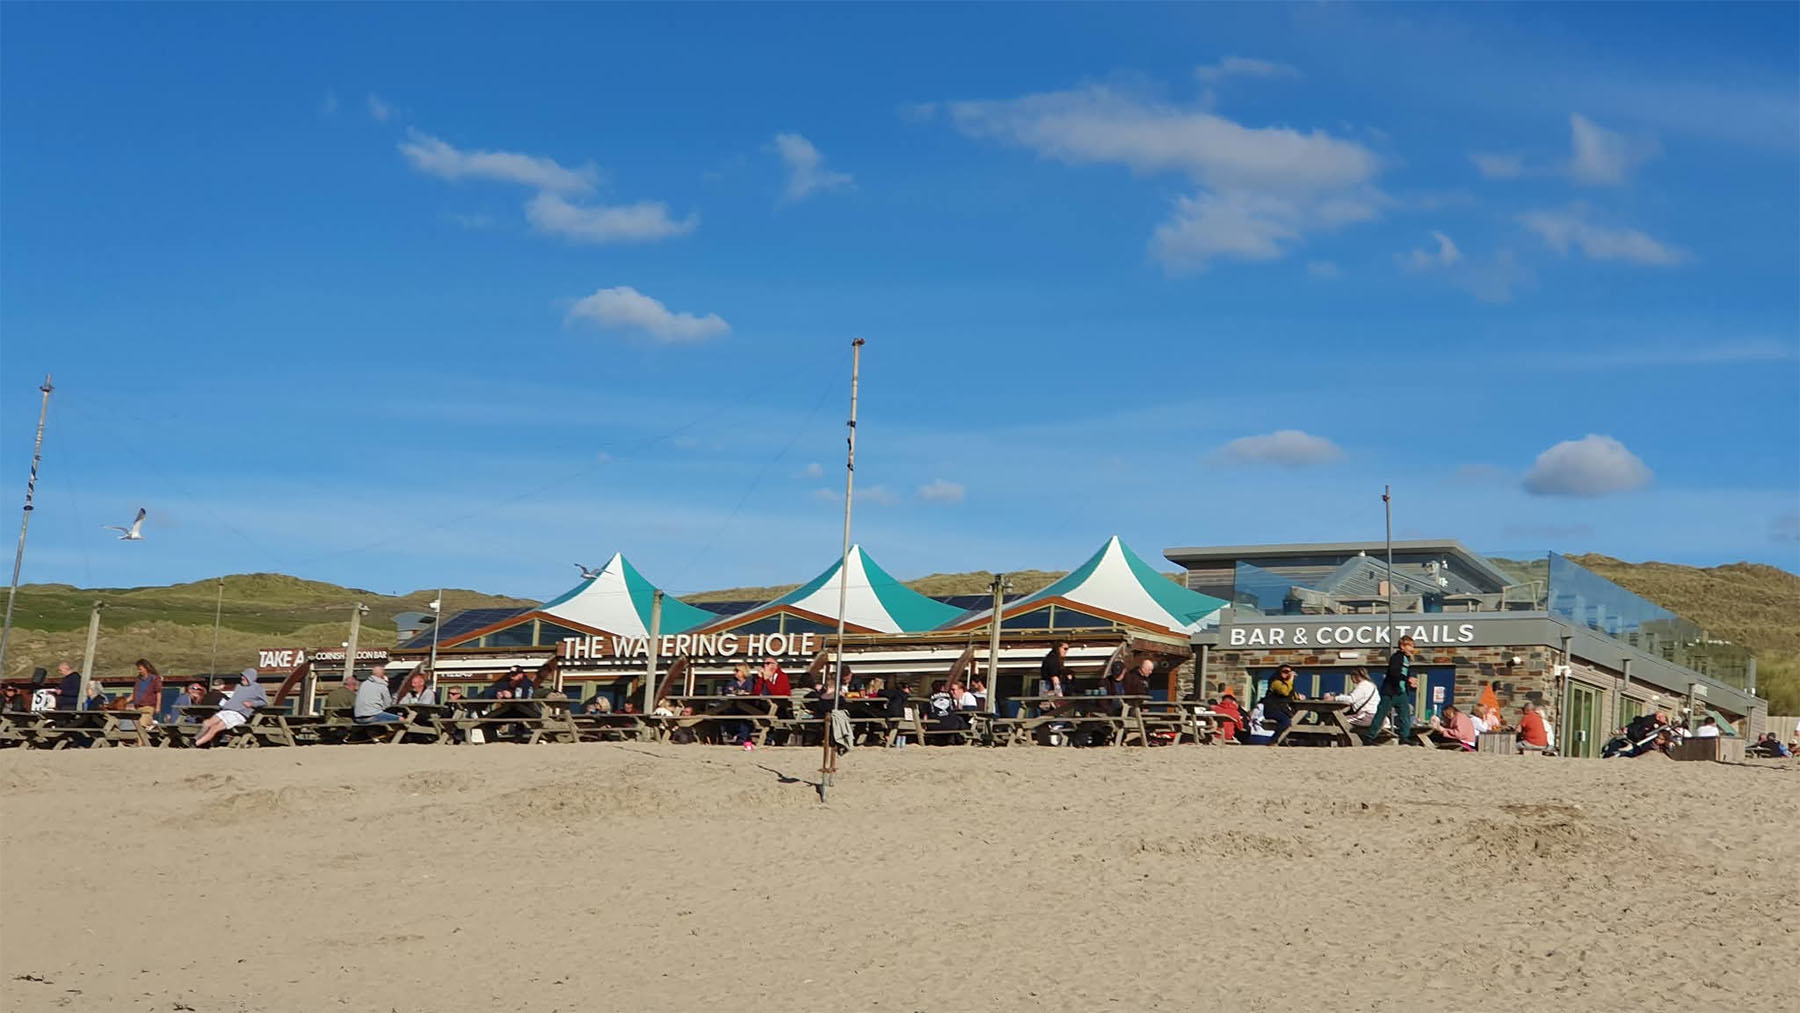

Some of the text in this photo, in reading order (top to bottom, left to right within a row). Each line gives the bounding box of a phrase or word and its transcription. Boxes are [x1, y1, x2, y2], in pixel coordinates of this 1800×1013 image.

[1230, 623, 1474, 646] BAR & COCKTAILS
[374, 650, 387, 659] BAR
[563, 632, 815, 659] THE WAERING HOLE
[259, 650, 292, 667] TAKE
